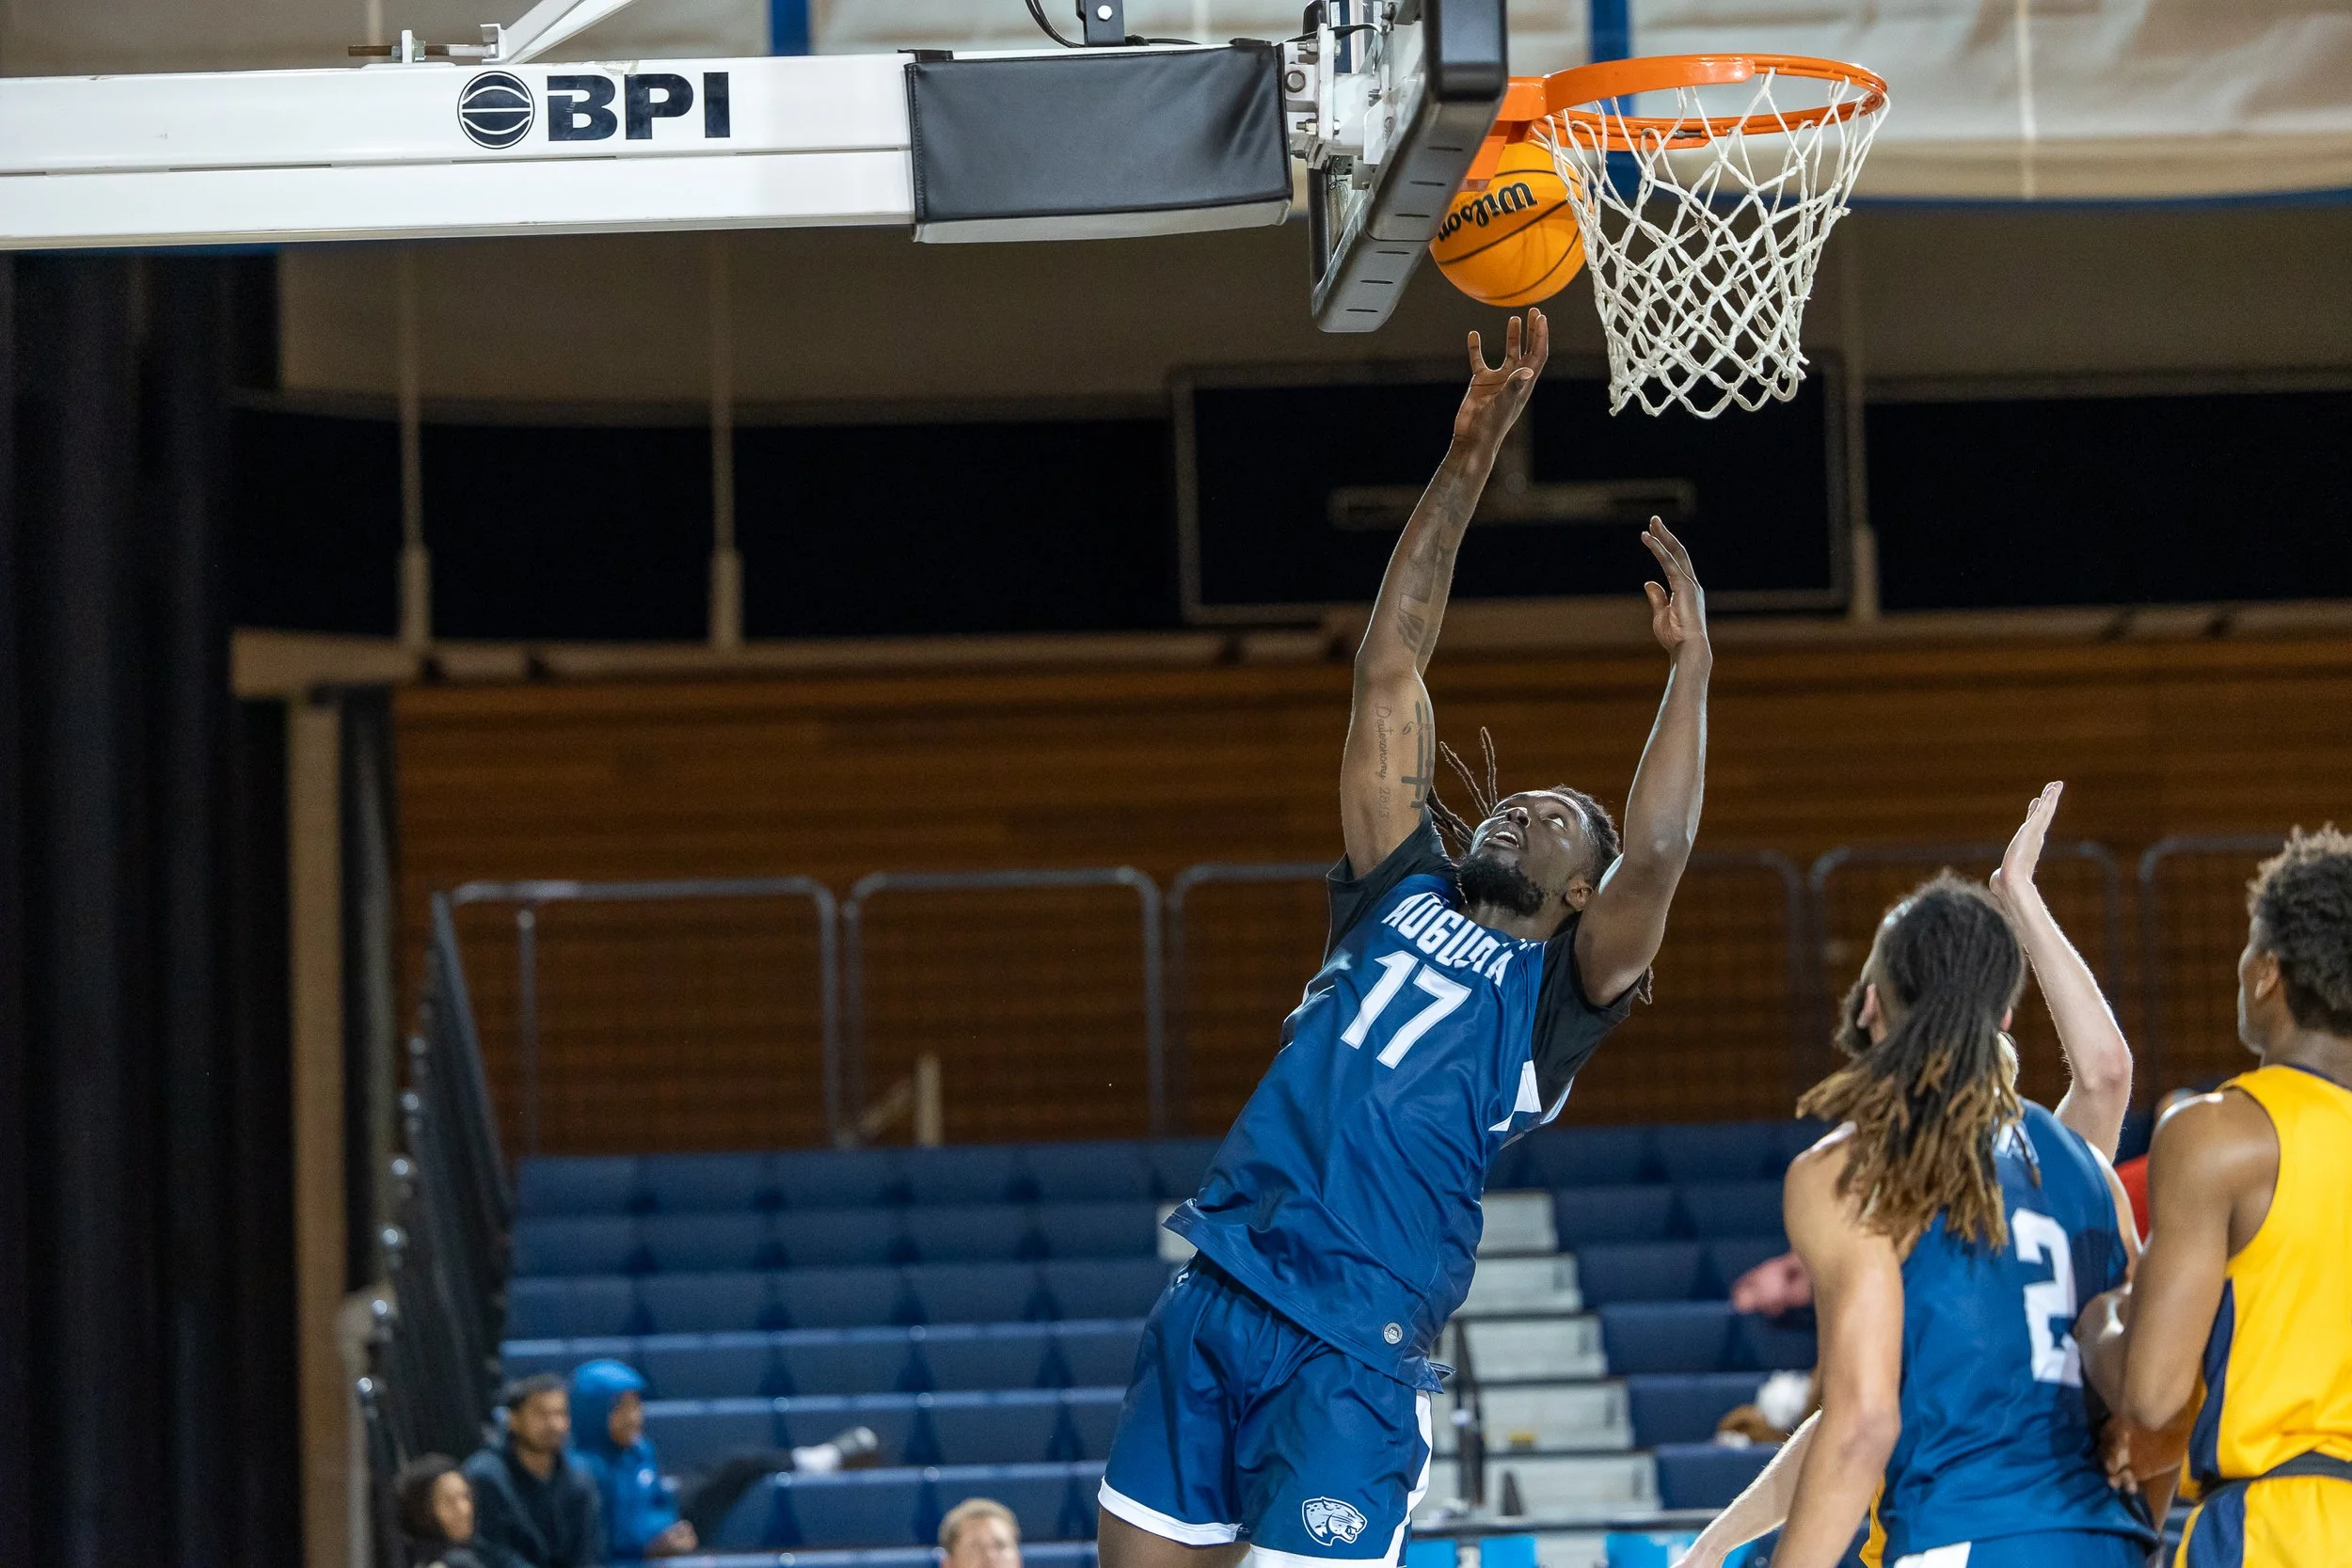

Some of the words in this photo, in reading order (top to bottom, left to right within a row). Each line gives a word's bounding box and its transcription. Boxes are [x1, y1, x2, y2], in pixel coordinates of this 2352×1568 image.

[547, 71, 730, 141] BPI
[1438, 182, 1538, 242] Wilson
[1340, 949, 1472, 1069] 17
[2010, 1207, 2084, 1388] 2
